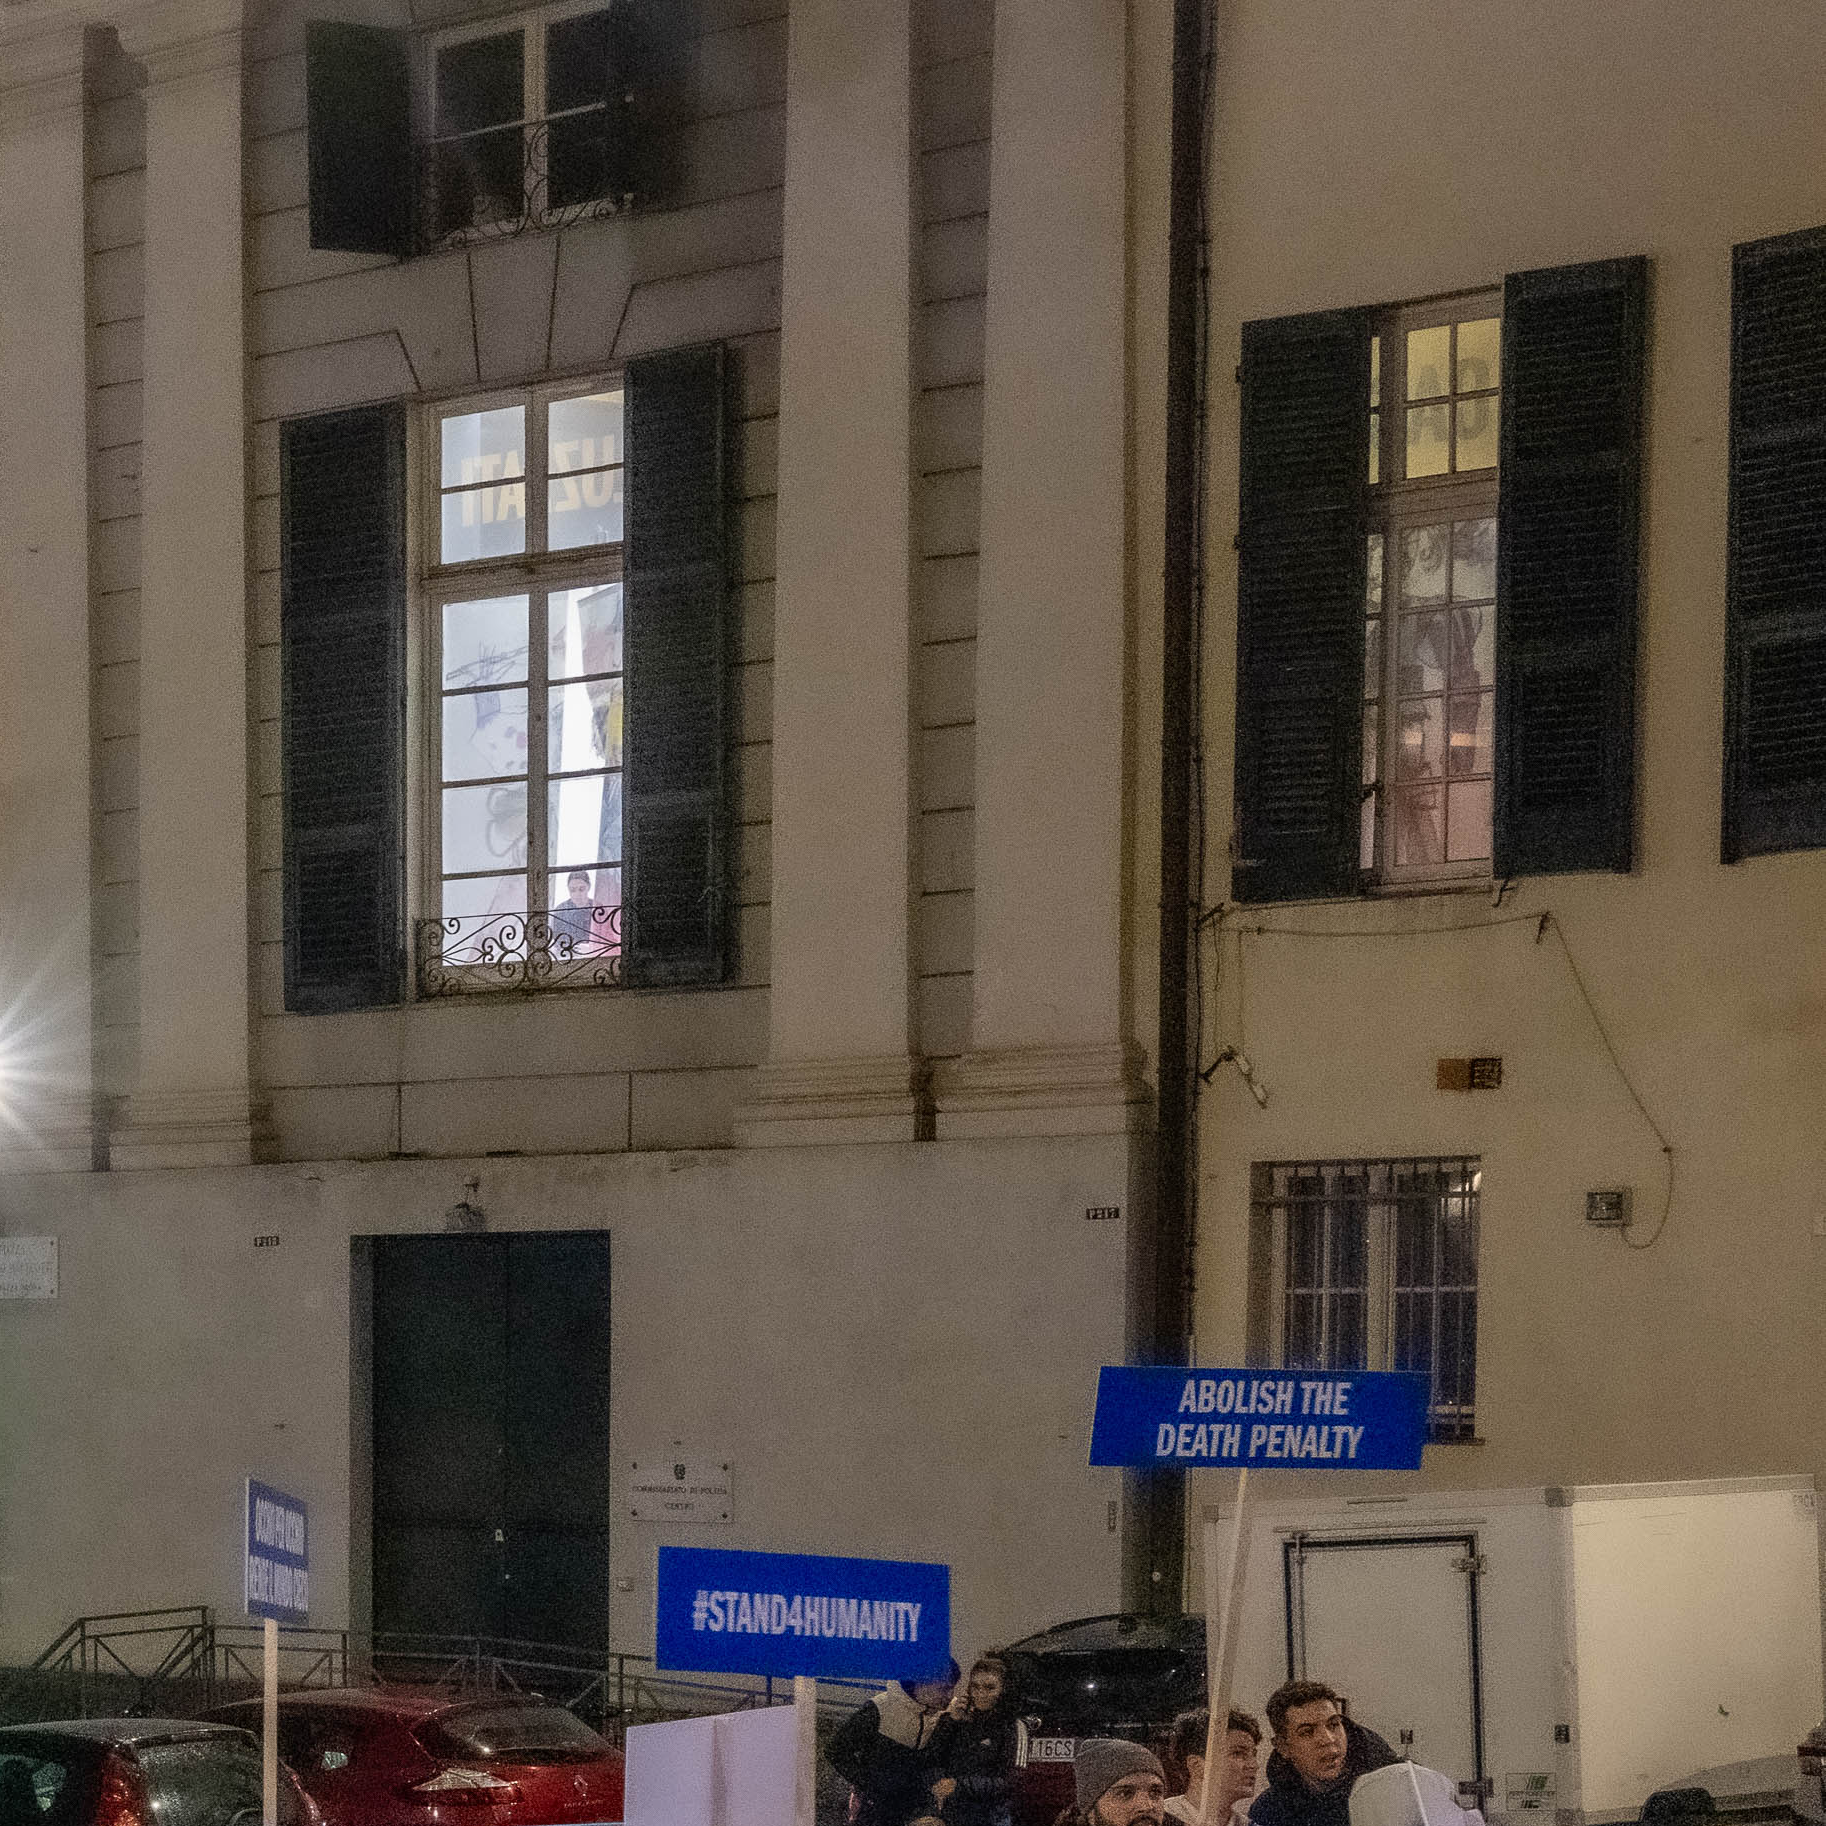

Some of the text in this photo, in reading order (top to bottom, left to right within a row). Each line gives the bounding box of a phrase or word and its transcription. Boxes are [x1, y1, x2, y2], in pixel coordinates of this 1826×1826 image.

[1178, 1379, 1353, 1416] ABOLISH THE
[1155, 1423, 1365, 1459] DEATH PENALTY
[693, 1590, 922, 1643] #STAND4HUMANITY
